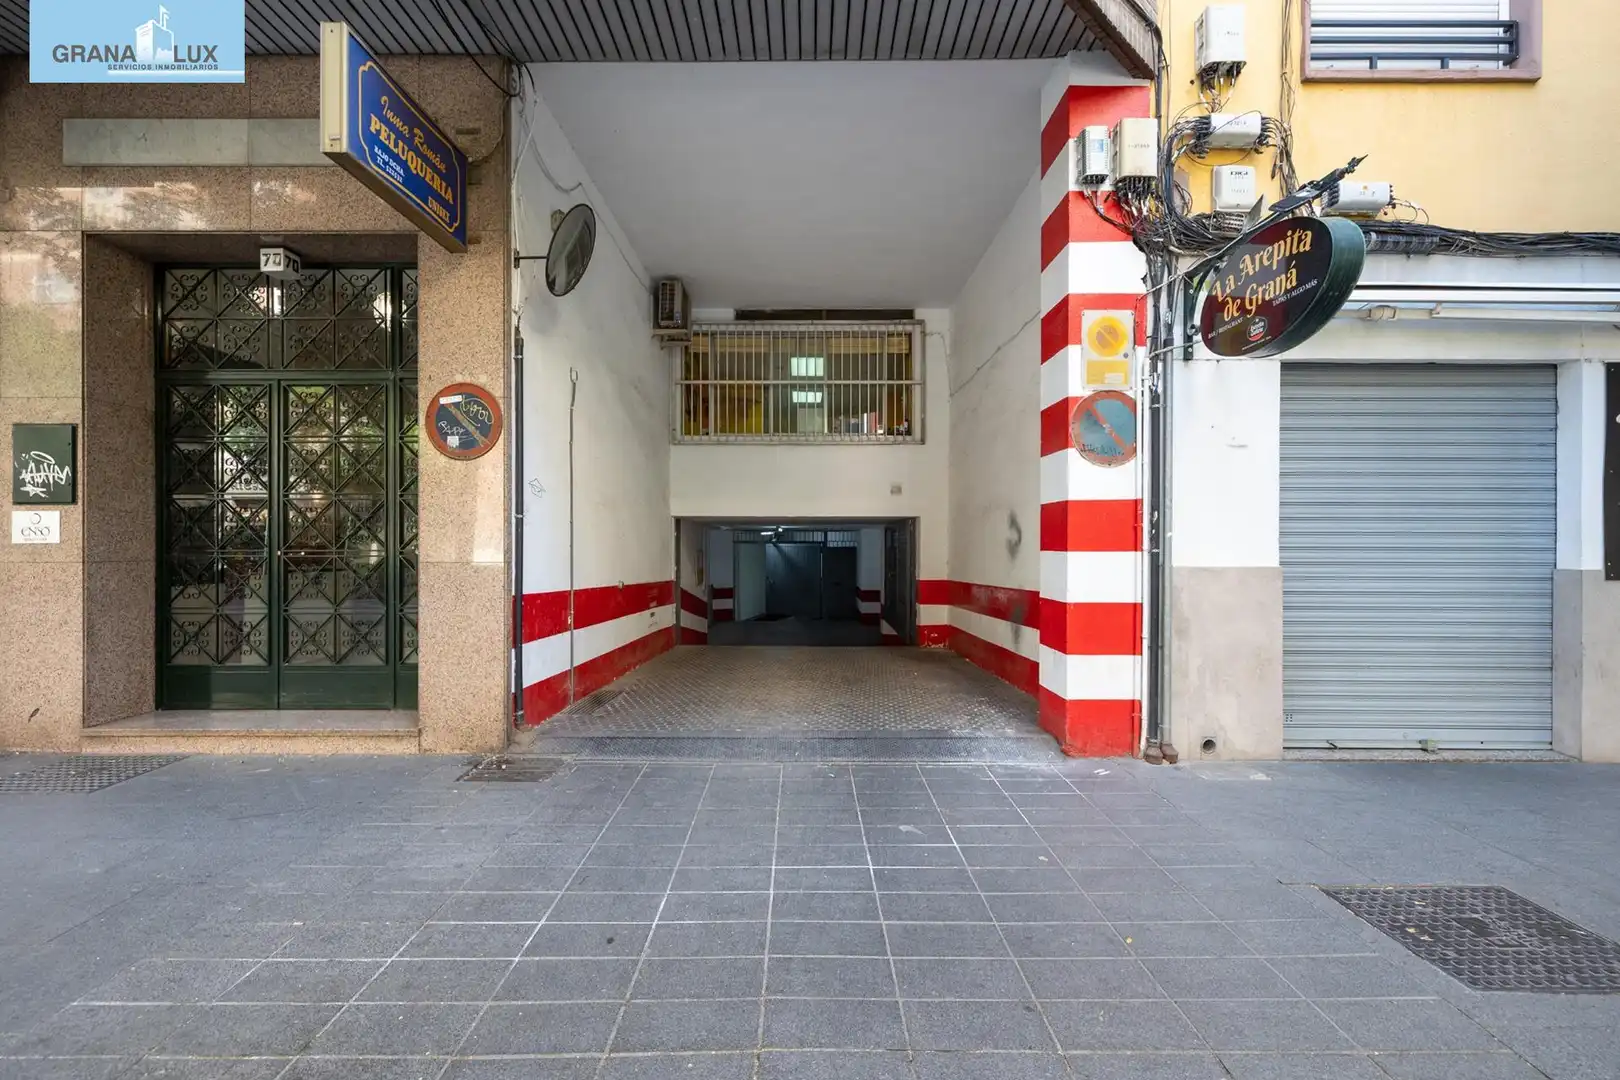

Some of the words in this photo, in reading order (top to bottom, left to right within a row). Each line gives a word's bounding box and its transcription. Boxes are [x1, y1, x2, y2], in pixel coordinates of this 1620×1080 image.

[369, 113, 454, 205] PELUQUERIA
[1212, 273, 1235, 303] La
[1237, 228, 1312, 285] Arepita
[1223, 296, 1241, 322] de
[1245, 260, 1297, 318] Graná
